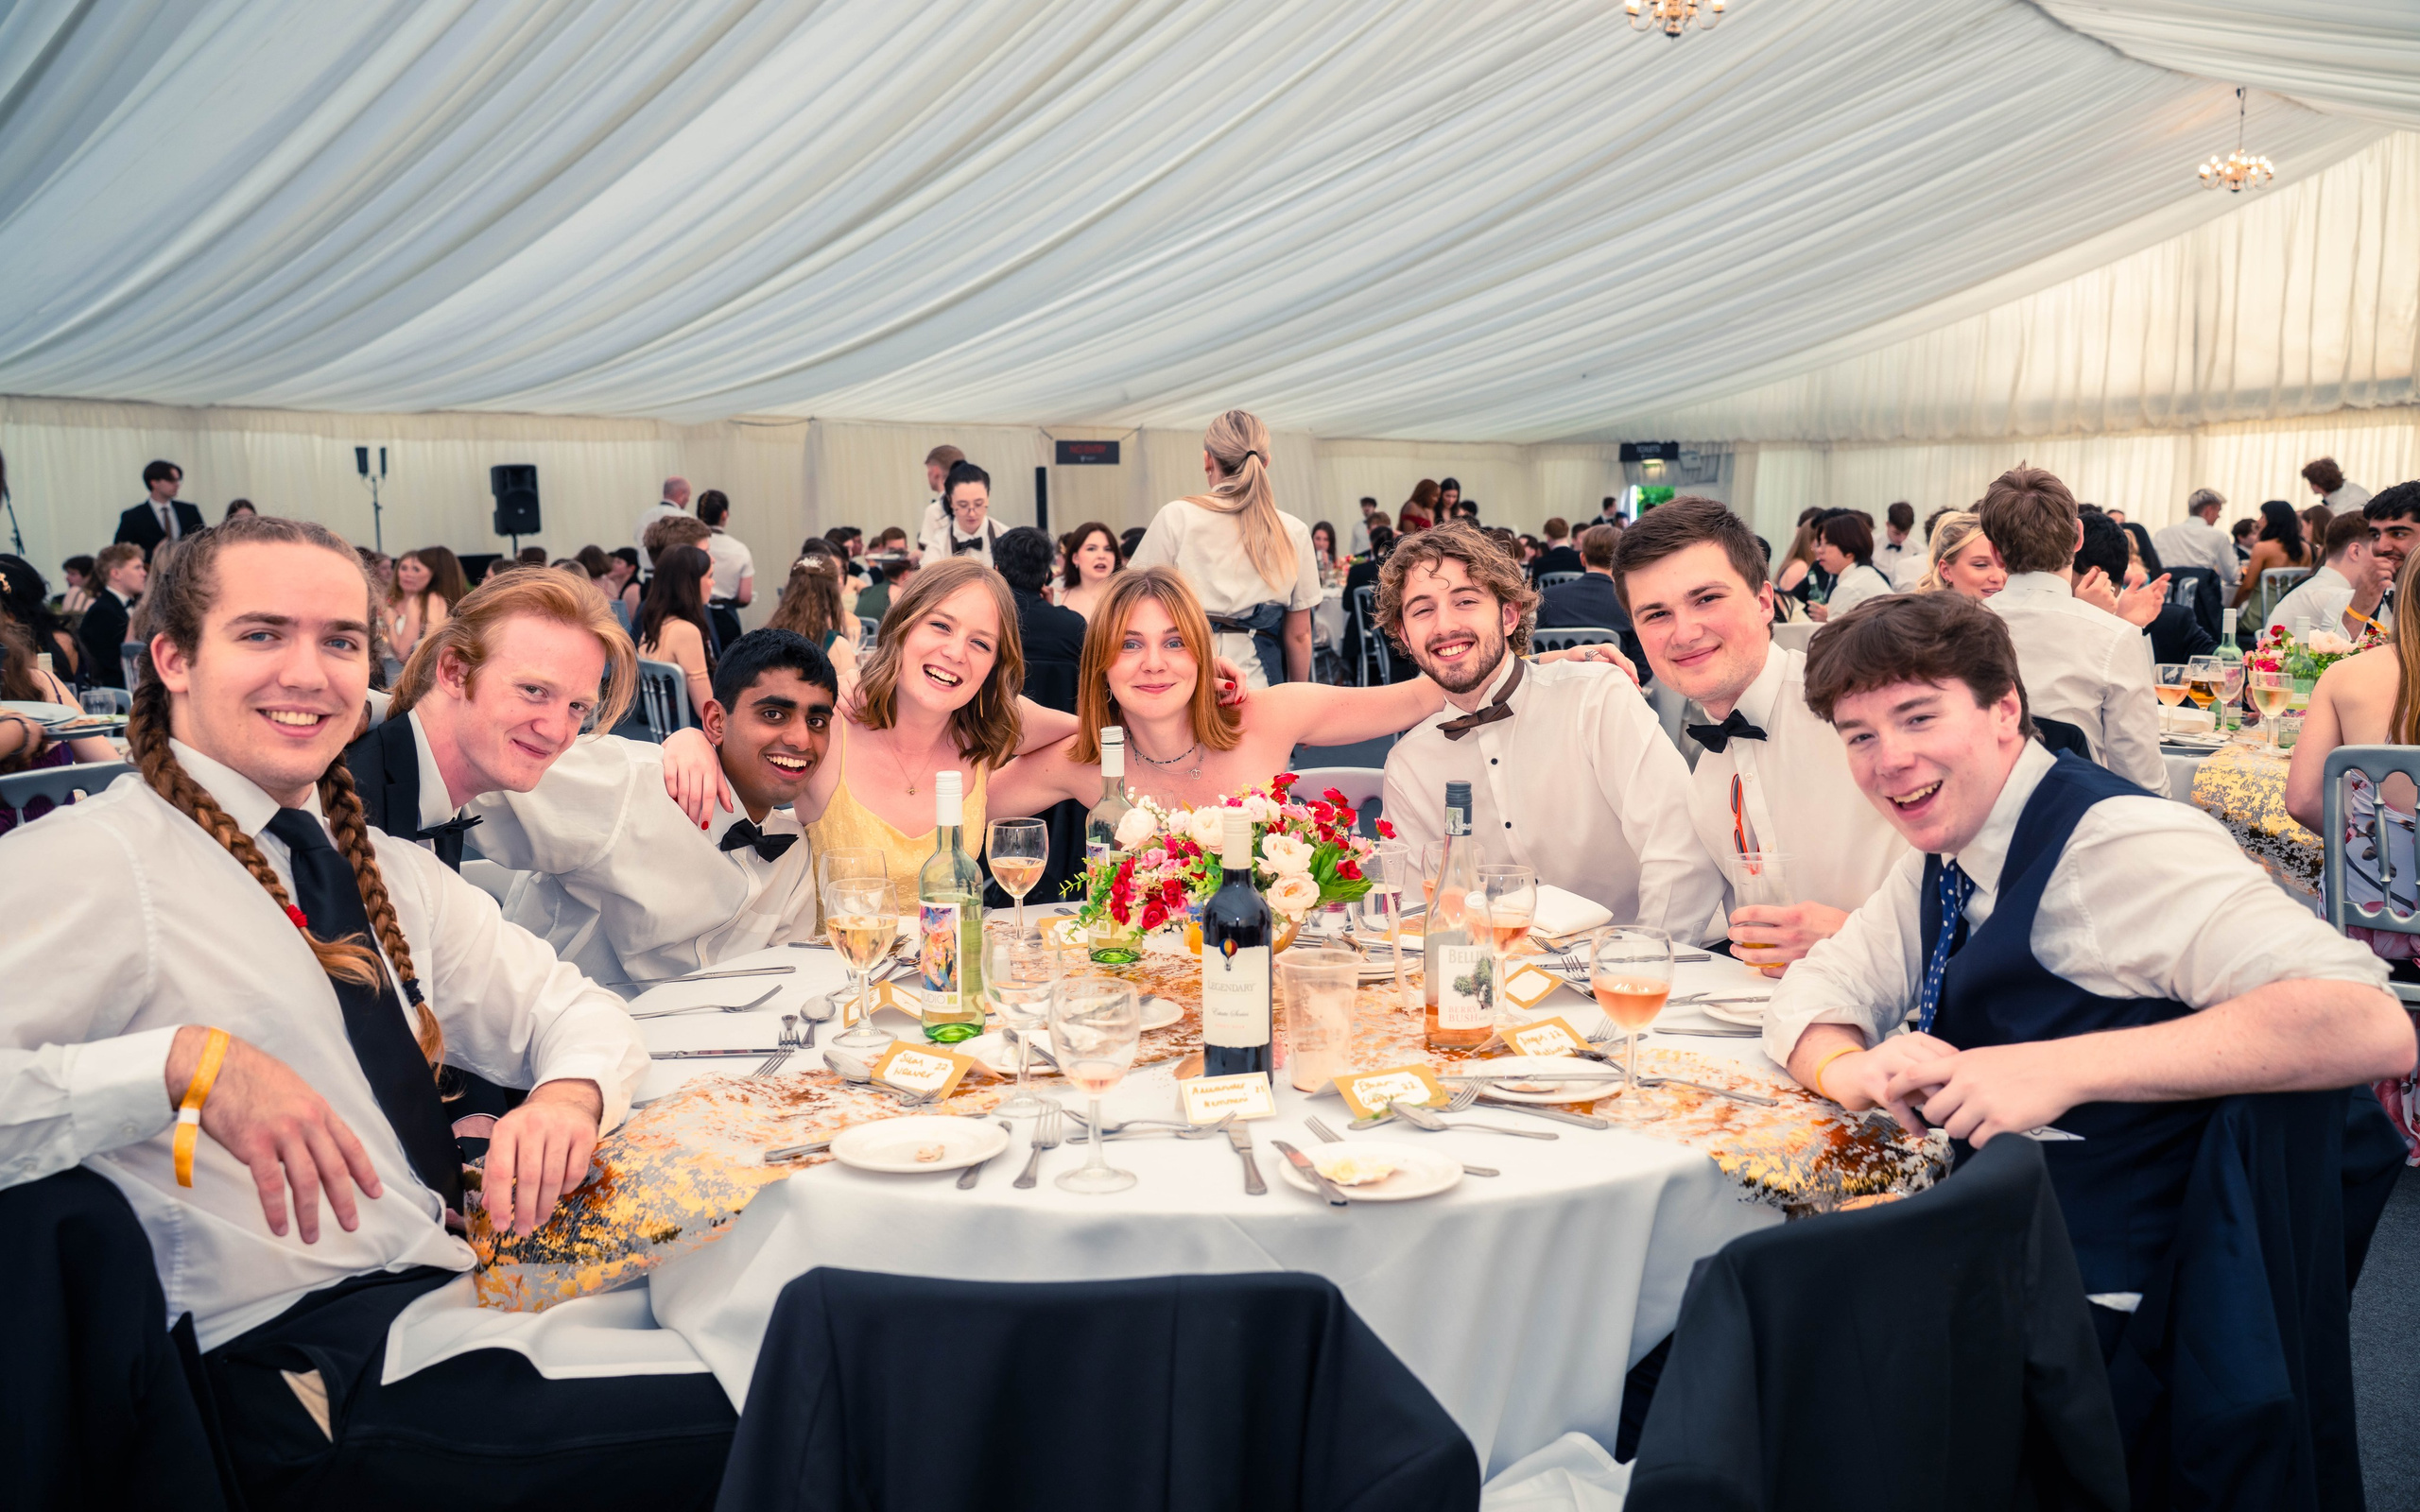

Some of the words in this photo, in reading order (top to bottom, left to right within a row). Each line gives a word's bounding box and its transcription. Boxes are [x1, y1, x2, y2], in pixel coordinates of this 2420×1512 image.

[1635, 445, 1661, 454] TOILETS
[1207, 979, 1254, 992] LEGENDARY
[1448, 1005, 1478, 1014] BERRY
[1448, 1014, 1478, 1022] BUSH
[934, 1062, 948, 1071] 22
